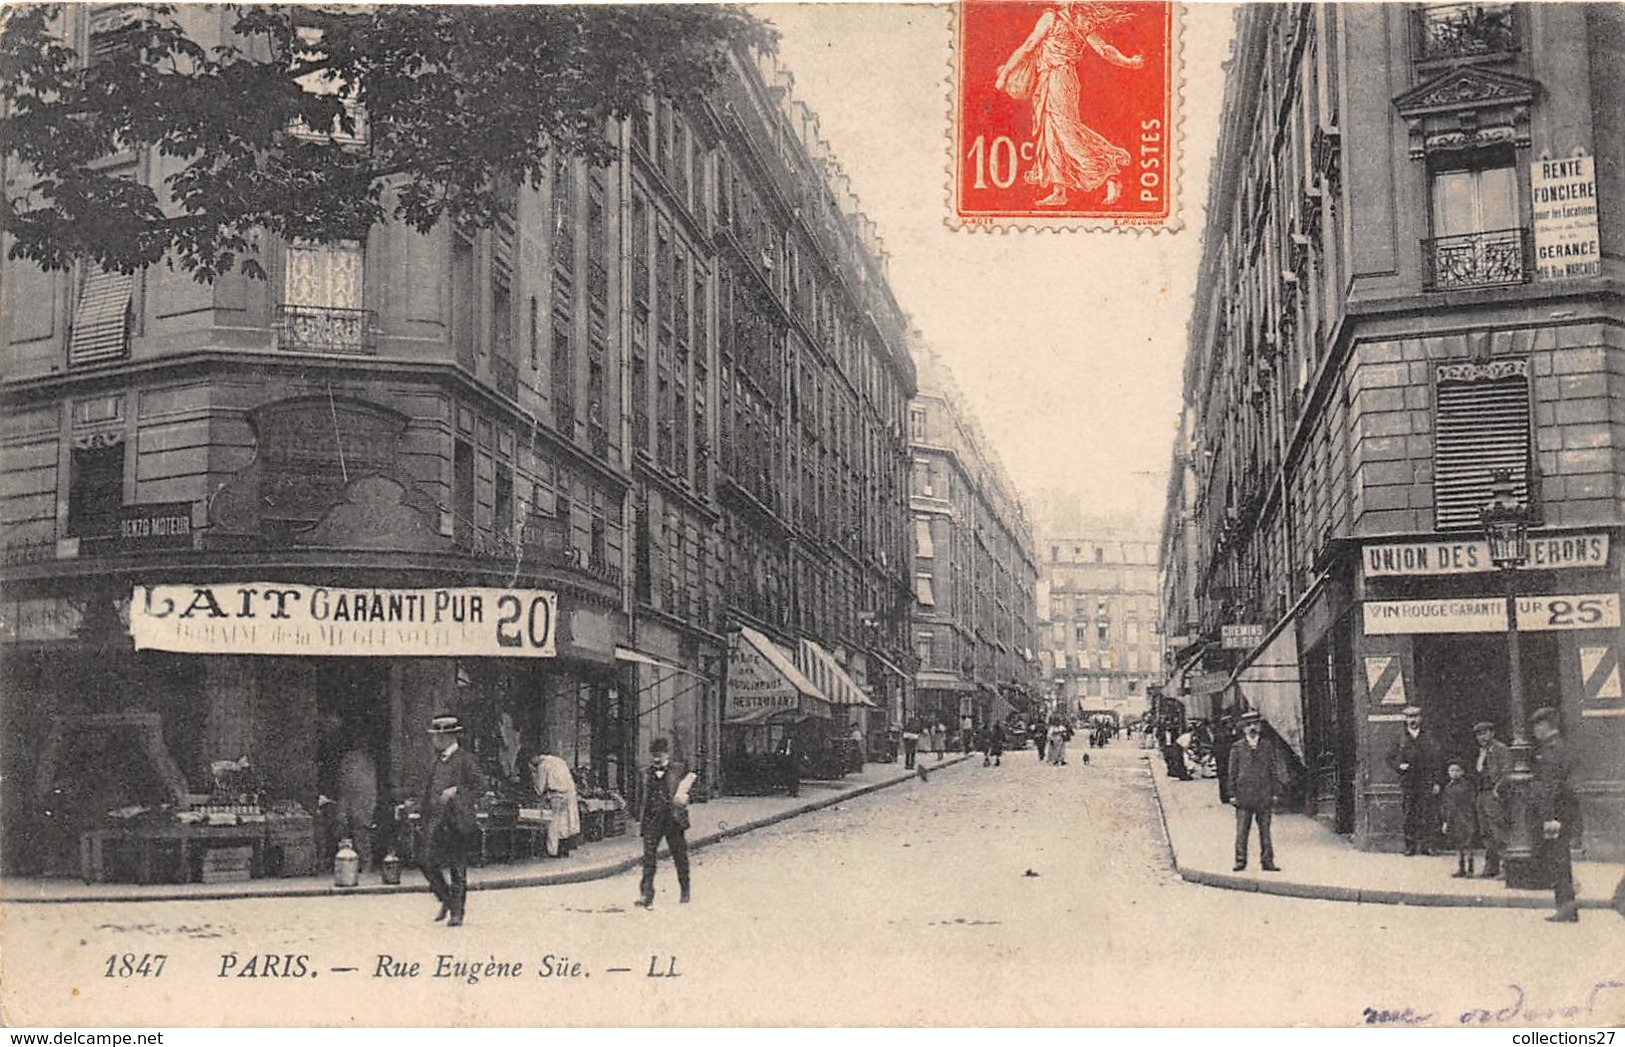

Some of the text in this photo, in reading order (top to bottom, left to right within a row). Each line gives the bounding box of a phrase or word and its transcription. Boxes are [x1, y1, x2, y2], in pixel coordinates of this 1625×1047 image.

[1140, 118, 1161, 202] POSTES
[1543, 160, 1583, 180] RENTE
[1533, 181, 1595, 203] FONCIERE
[1540, 241, 1597, 259] GERANCE
[152, 516, 189, 536] MOTEUR
[1370, 546, 1428, 571] UNION
[1438, 544, 1478, 568] DES
[143, 584, 301, 620] LAIT
[310, 587, 426, 622] GARANTI
[433, 589, 484, 624] PUR
[1369, 604, 1399, 618] VIN
[1402, 603, 1448, 617] ROUGE
[1450, 602, 1502, 617] GARANTI
[1518, 601, 1544, 614] UR
[1222, 625, 1263, 637] CHEMINS
[1226, 637, 1241, 648] DE
